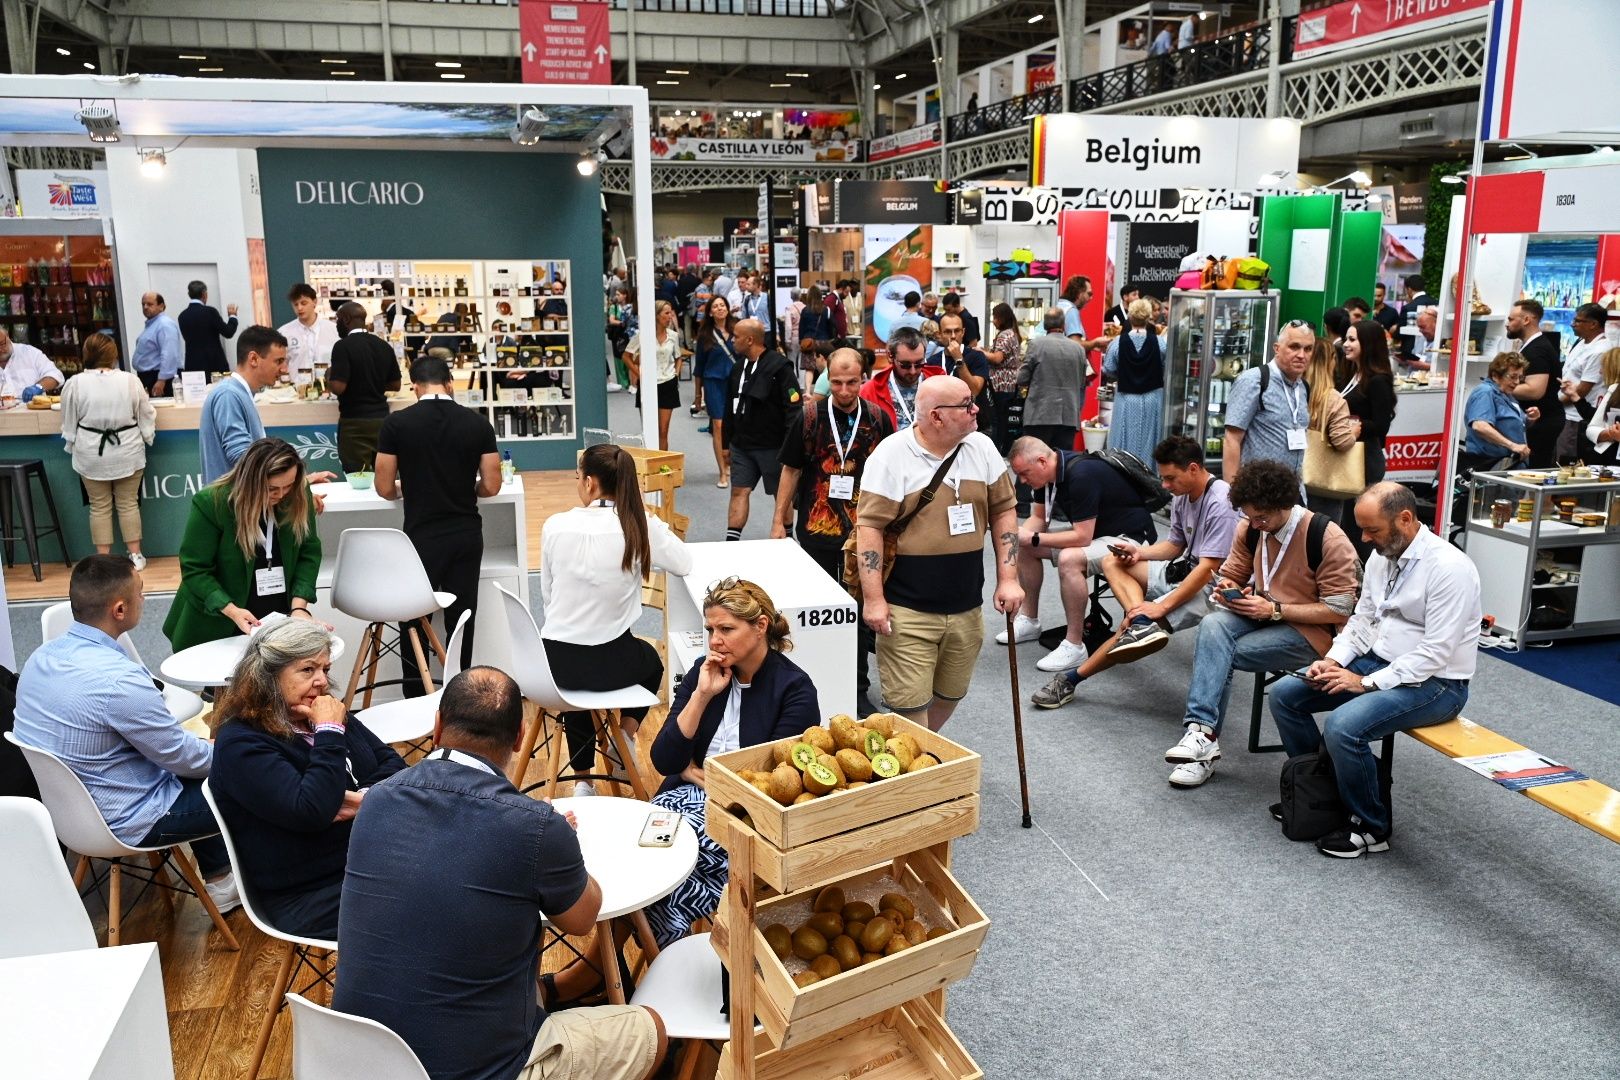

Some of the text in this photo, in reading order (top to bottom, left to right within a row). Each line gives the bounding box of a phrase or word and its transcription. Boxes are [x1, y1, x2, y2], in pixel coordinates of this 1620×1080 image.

[543, 25, 586, 34] MEMBERS LOUNGE
[546, 36, 585, 45] TRENDS THEATRE
[568, 48, 586, 57] VILLAGE
[540, 59, 565, 68] PRODUCER
[576, 72, 589, 80] FOOD
[698, 141, 803, 155] CASTILLA Y LEÓN
[1086, 137, 1201, 171] Belgium
[72, 186, 92, 194] Taste
[295, 180, 424, 206] DELICARIO
[72, 194, 93, 202] West
[1556, 194, 1576, 207] 1830A
[886, 202, 919, 211] BELGIUM
[1136, 244, 1190, 255] Authentically
[1140, 267, 1179, 277] Deliciousl
[797, 607, 857, 627] 1820b
